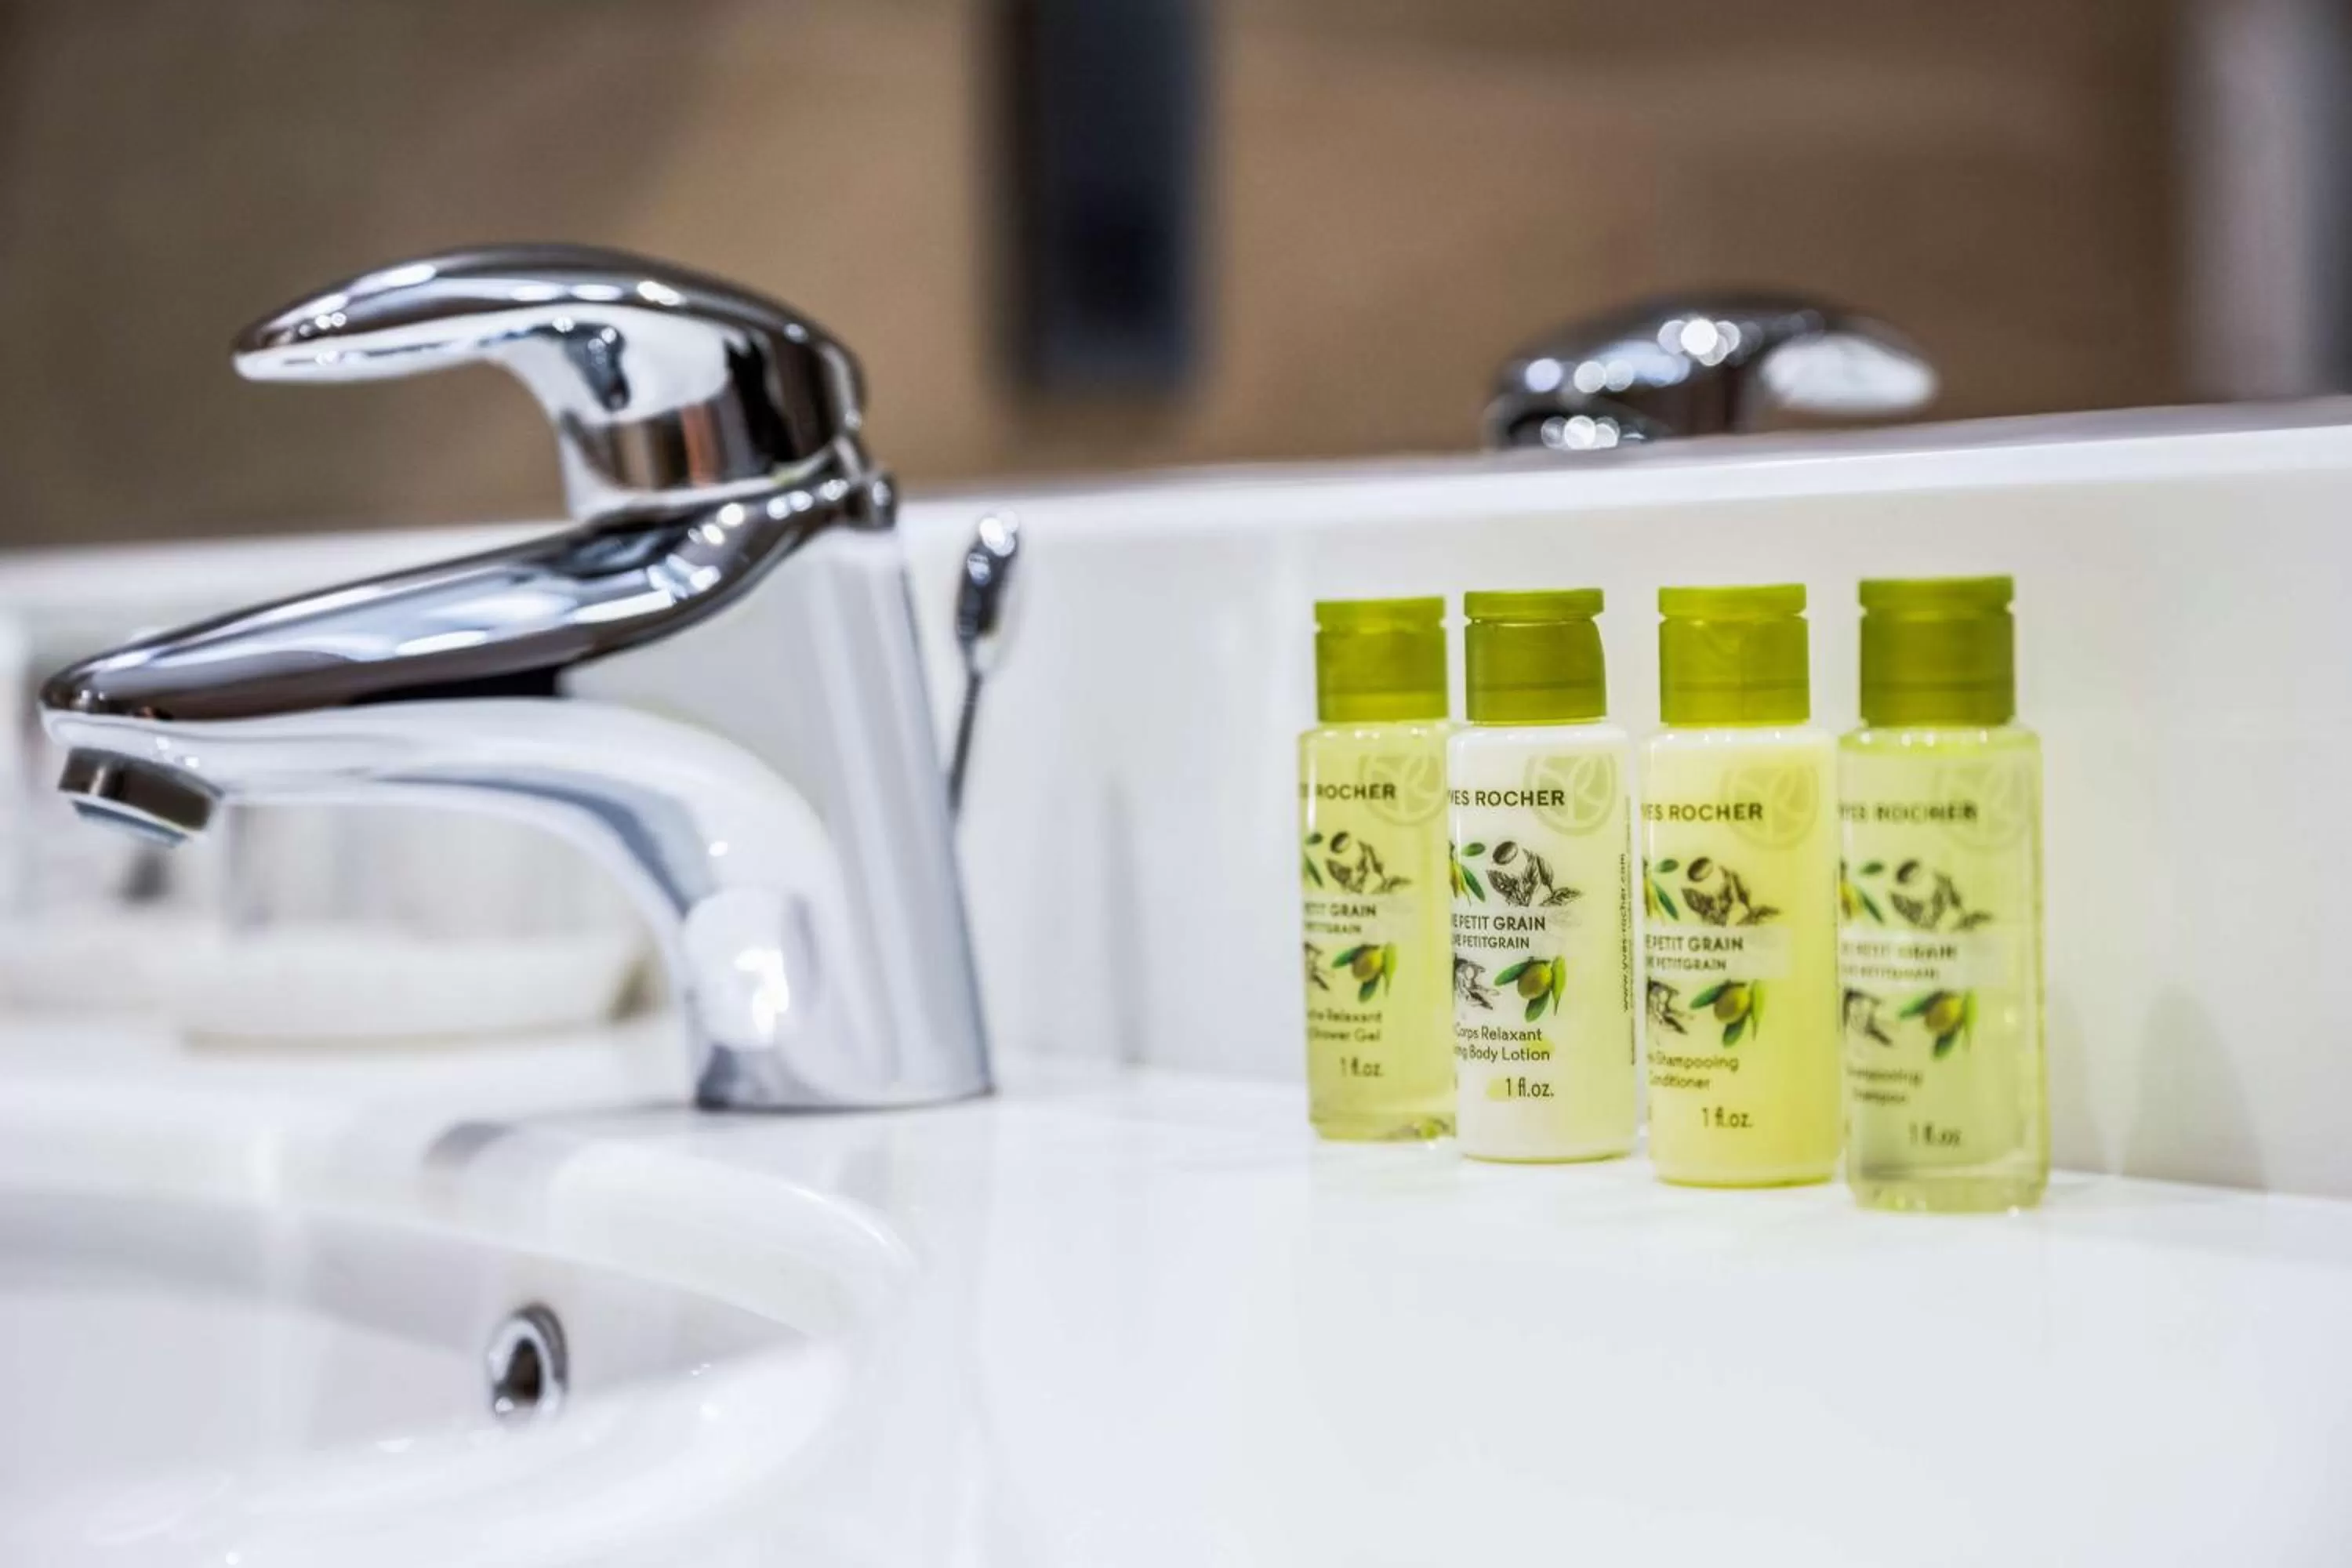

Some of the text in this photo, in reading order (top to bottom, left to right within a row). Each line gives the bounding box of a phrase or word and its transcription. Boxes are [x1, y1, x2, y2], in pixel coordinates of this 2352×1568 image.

[1475, 789, 1566, 807] ROCHER
[1668, 802, 1763, 821] ROCHER
[1330, 902, 1377, 917] GRAIN
[1459, 915, 1490, 930] PETIT
[1493, 916, 1546, 931] GRAIN
[1463, 935, 1530, 949] PETITGRAIN
[1688, 935, 1744, 951] GRAIN
[1355, 1027, 1381, 1042] Gel
[1482, 1025, 1543, 1041] Relaxant
[1468, 1044, 1498, 1063] Body
[1501, 1047, 1550, 1062] Lotion
[1340, 1056, 1347, 1077] 1
[1505, 1076, 1555, 1098] 1 fl.oz.
[1702, 1107, 1708, 1127] 1
